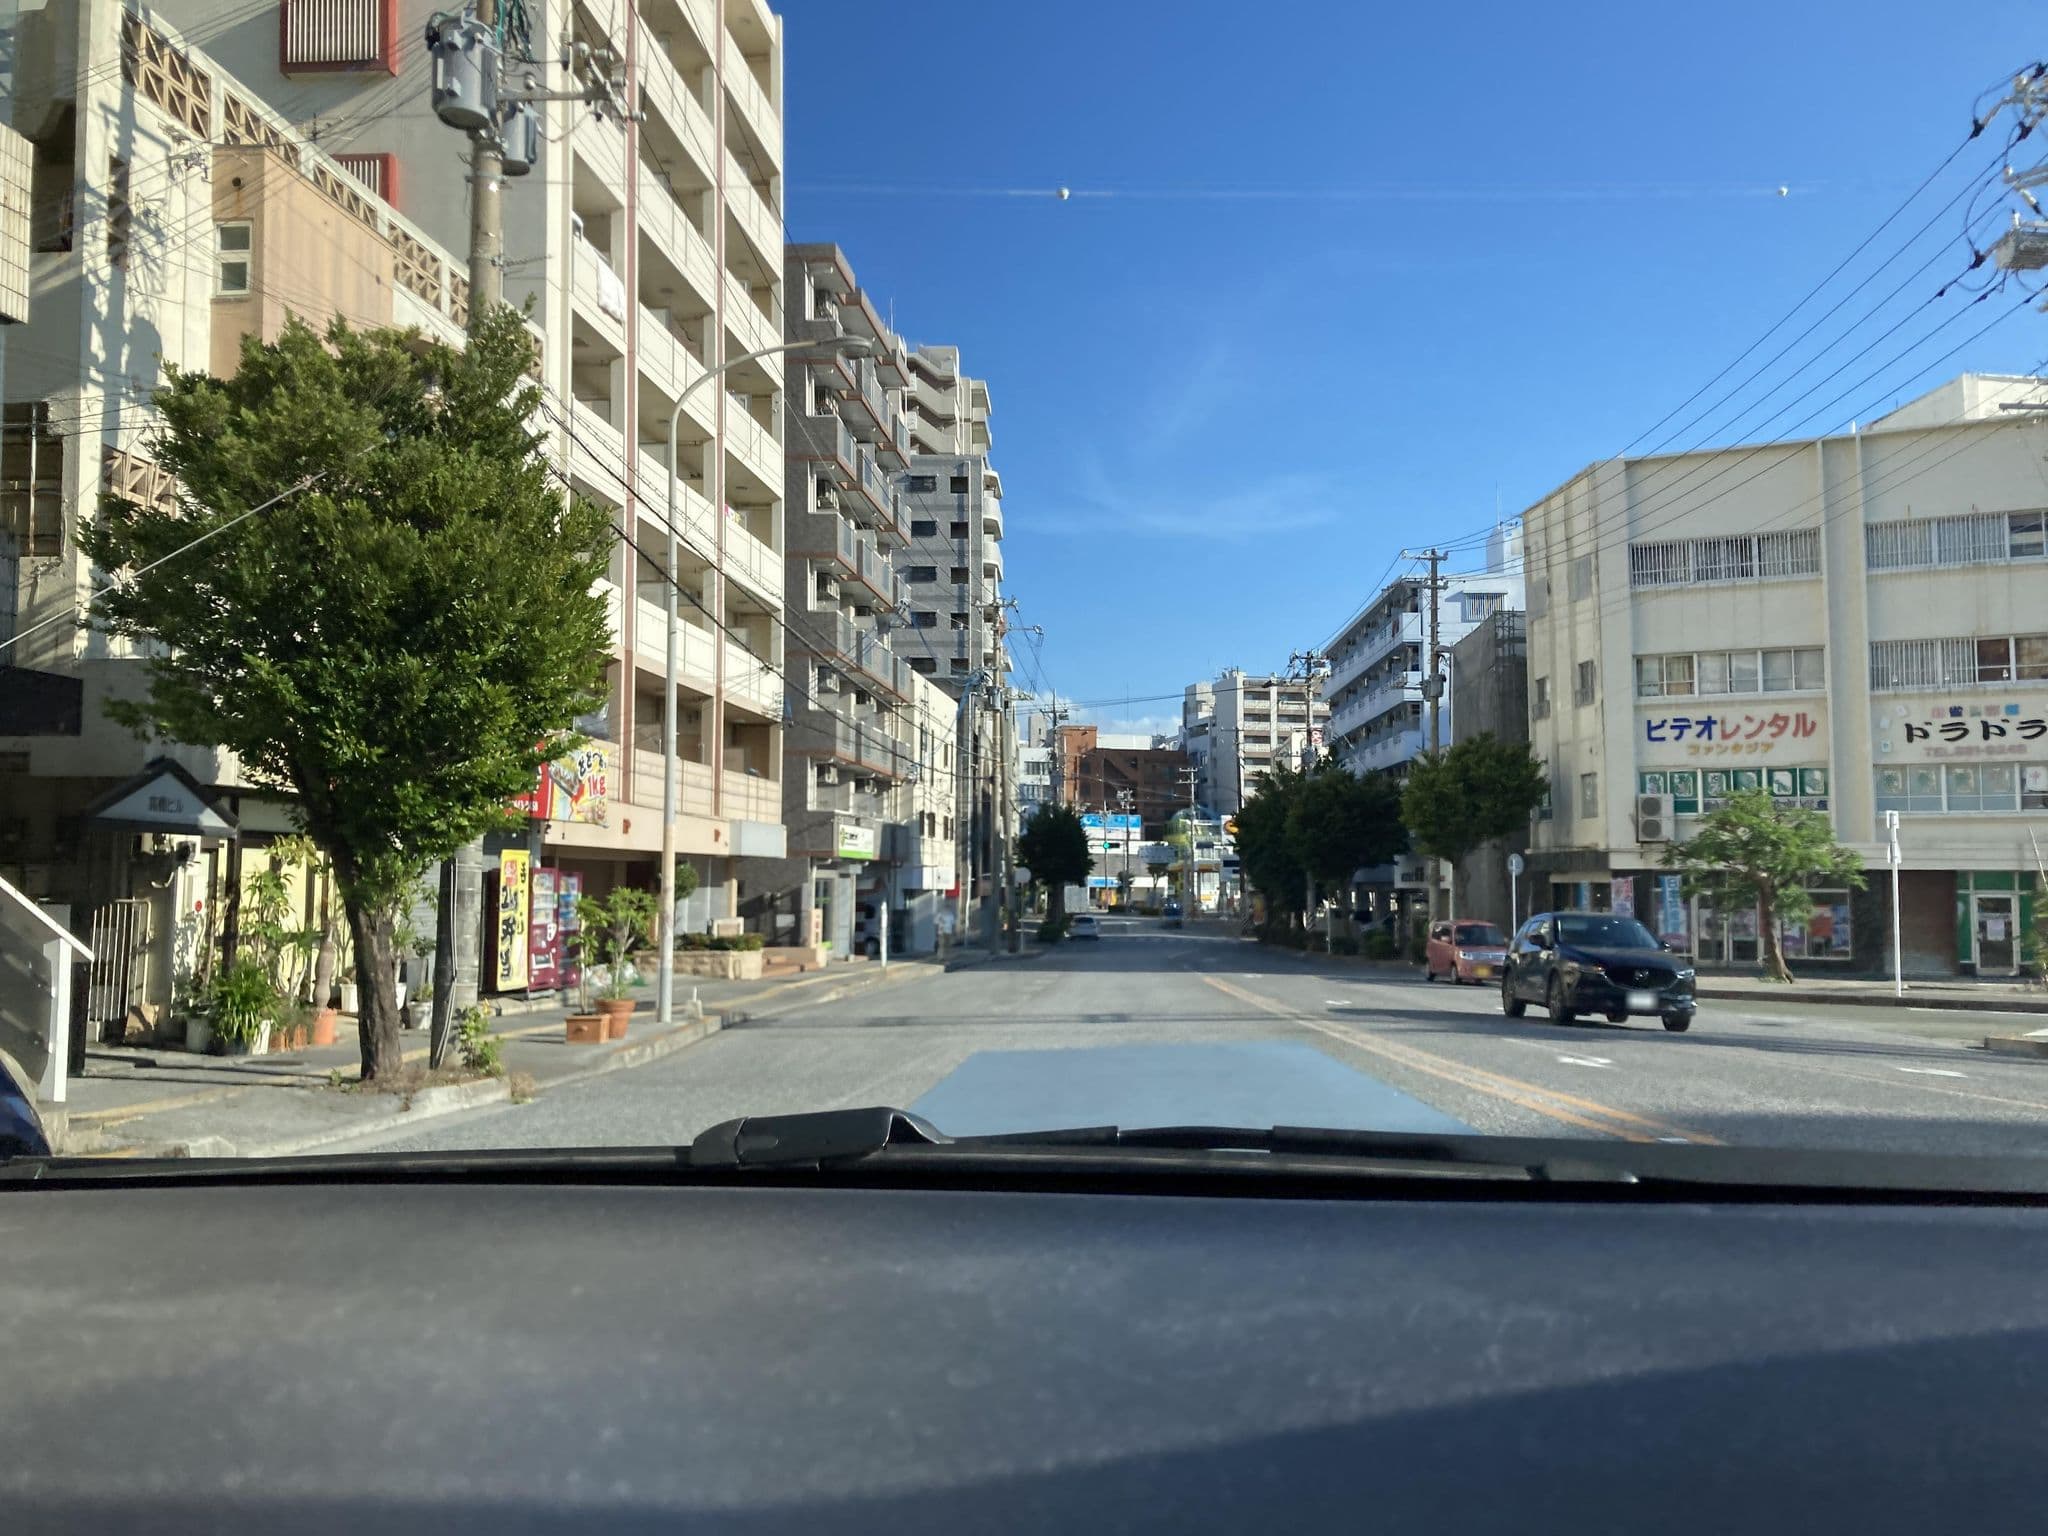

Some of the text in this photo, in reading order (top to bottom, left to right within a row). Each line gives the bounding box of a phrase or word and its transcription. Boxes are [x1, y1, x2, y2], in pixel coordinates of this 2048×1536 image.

[1646, 712, 1817, 742] ビデオレンタル
[1904, 718, 2048, 744] ドラドラ
